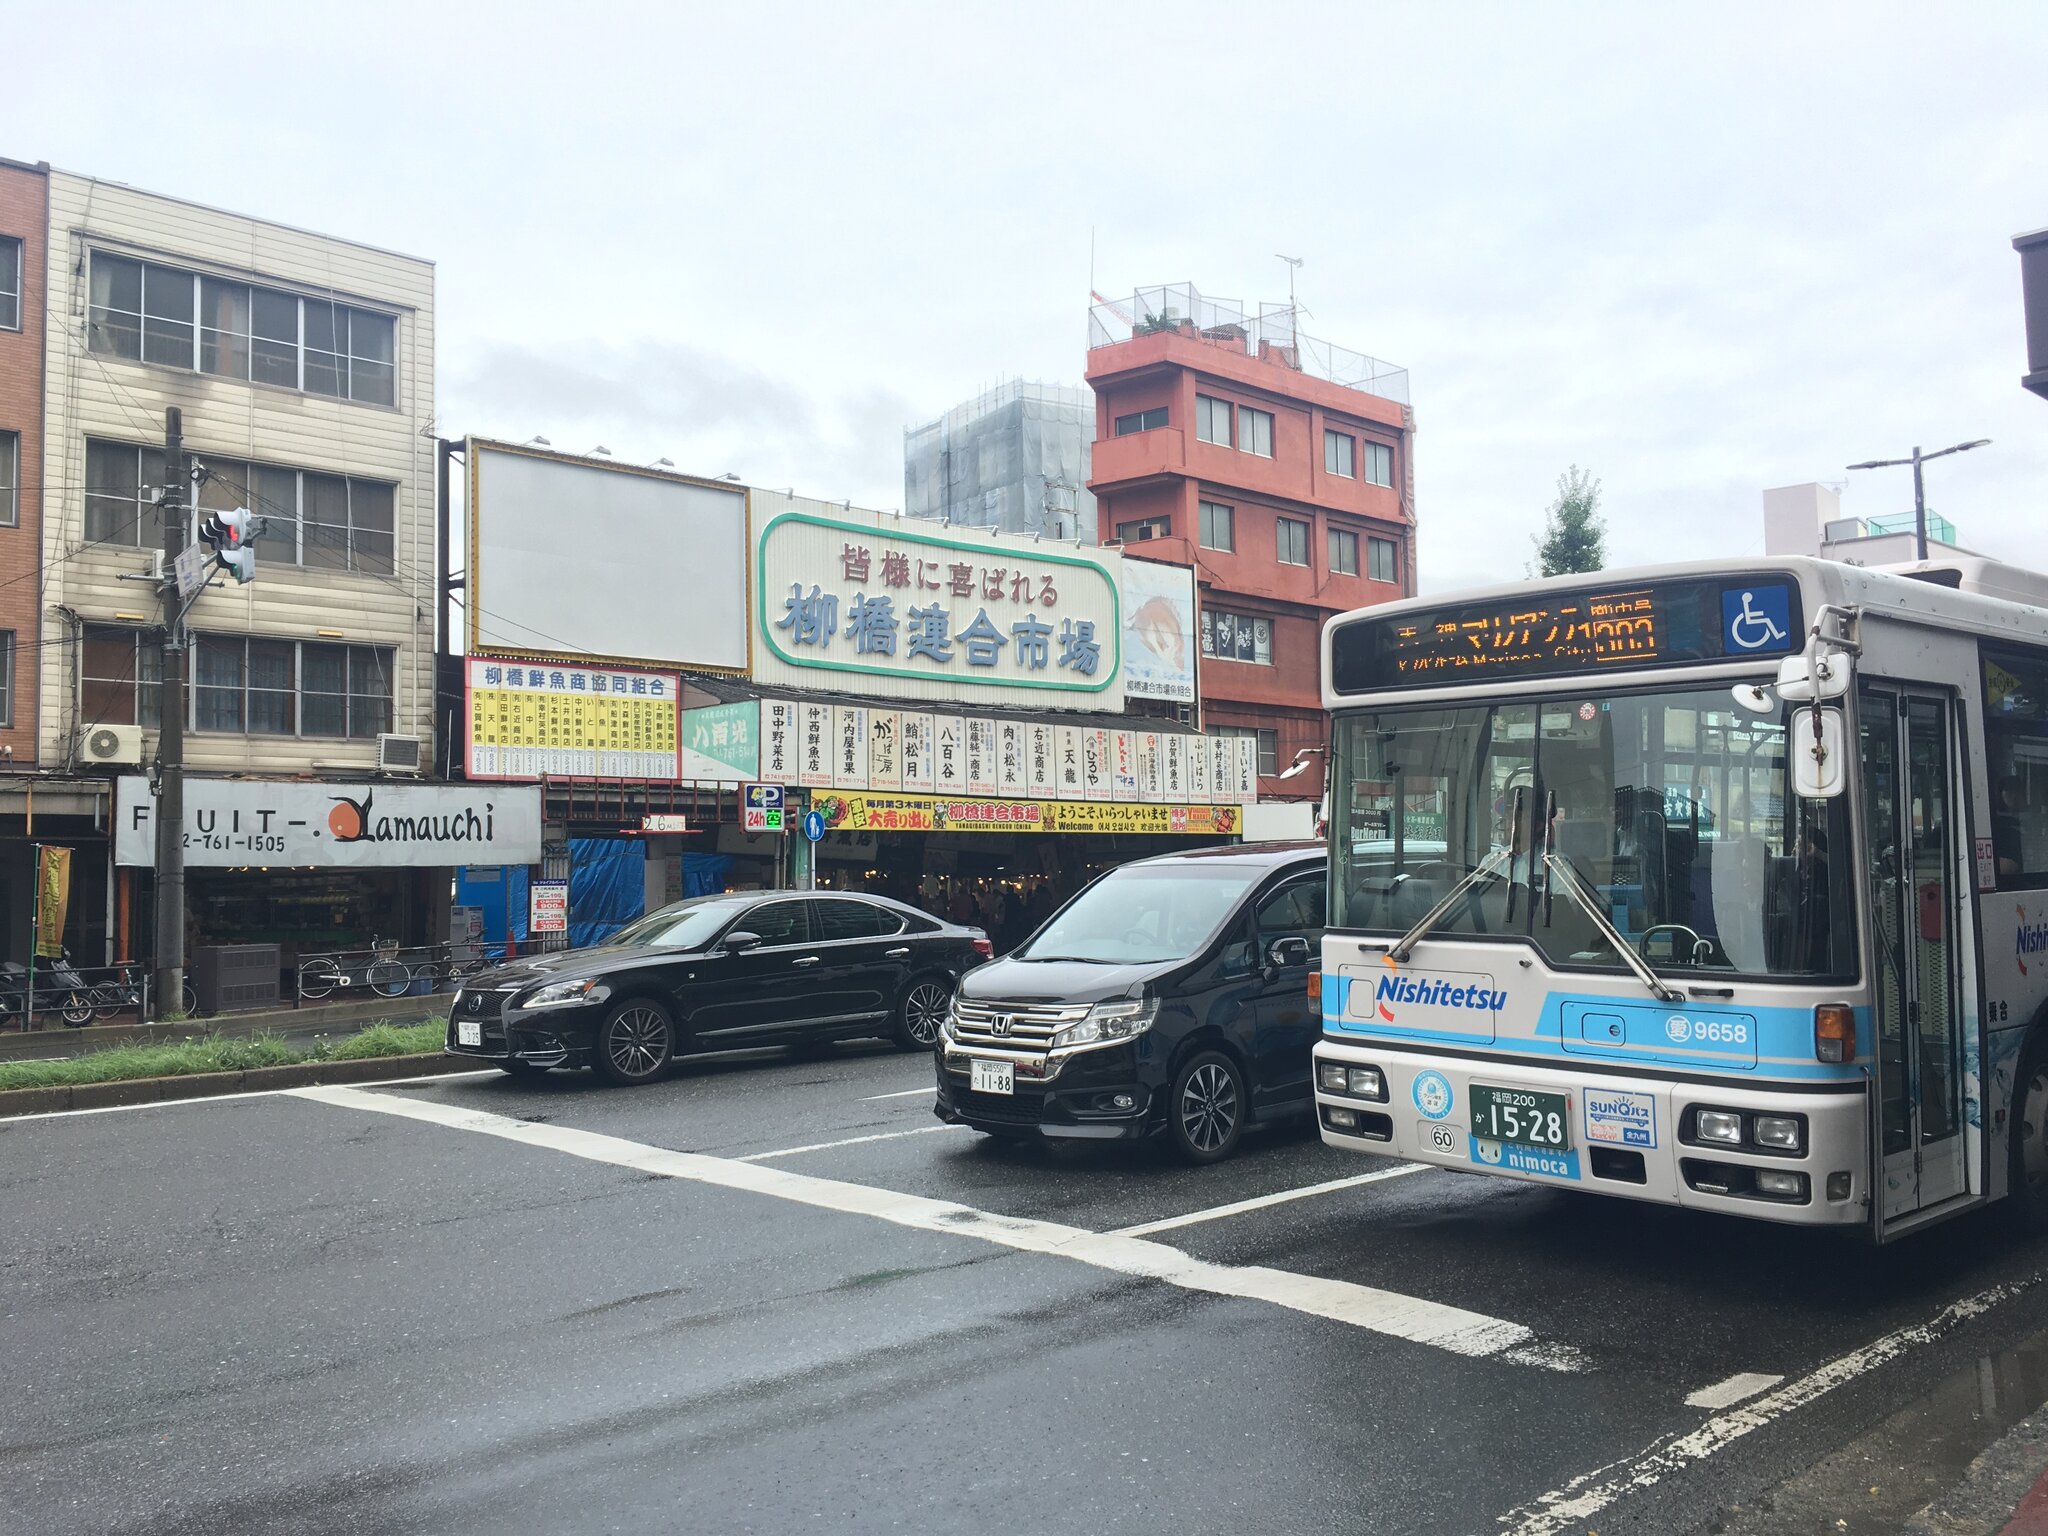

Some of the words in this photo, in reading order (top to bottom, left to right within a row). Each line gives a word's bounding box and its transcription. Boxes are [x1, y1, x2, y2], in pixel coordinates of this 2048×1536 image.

[840, 542, 1059, 607] 皆様に喜ばれる
[775, 582, 1102, 676] 柳橋連合市場
[484, 665, 665, 697] 柳橋鮮魚商協同組合
[772, 705, 785, 771] 田中野菜店
[807, 707, 820, 772] 仲西鮮魚店
[843, 710, 855, 774] 河内屋青果
[941, 726, 955, 778] 八百谷
[969, 721, 980, 781] 佐藤純一商店
[1003, 725, 1016, 783] 肉の松永
[1034, 727, 1045, 783] 右近商店
[1064, 749, 1076, 784] 天龍
[1086, 749, 1099, 786] ひろや
[1169, 737, 1178, 791] 古賀鮮魚店
[1195, 739, 1203, 791] ふじはら
[328, 786, 494, 843] Yamauchi
[747, 810, 766, 827] 24h
[766, 809, 781, 829] 空
[866, 799, 932, 810] 毎月第3木曜日
[868, 809, 932, 829] 大売り出し
[947, 802, 1040, 822] 柳橋連合市場
[1058, 805, 1168, 820] ようこそ、いらっしゃいませ
[1058, 821, 1094, 831] Welcome
[1976, 842, 1993, 860] 出口
[1375, 974, 1508, 1011] Nishitetsu
[1694, 1021, 1748, 1044] 9658
[981, 1073, 1011, 1091] 11-88
[1433, 1131, 1453, 1147] 60
[1490, 1104, 1562, 1144] 15-28
[1626, 1131, 1647, 1141] 全九州
[1509, 1151, 1568, 1175] nimoca
